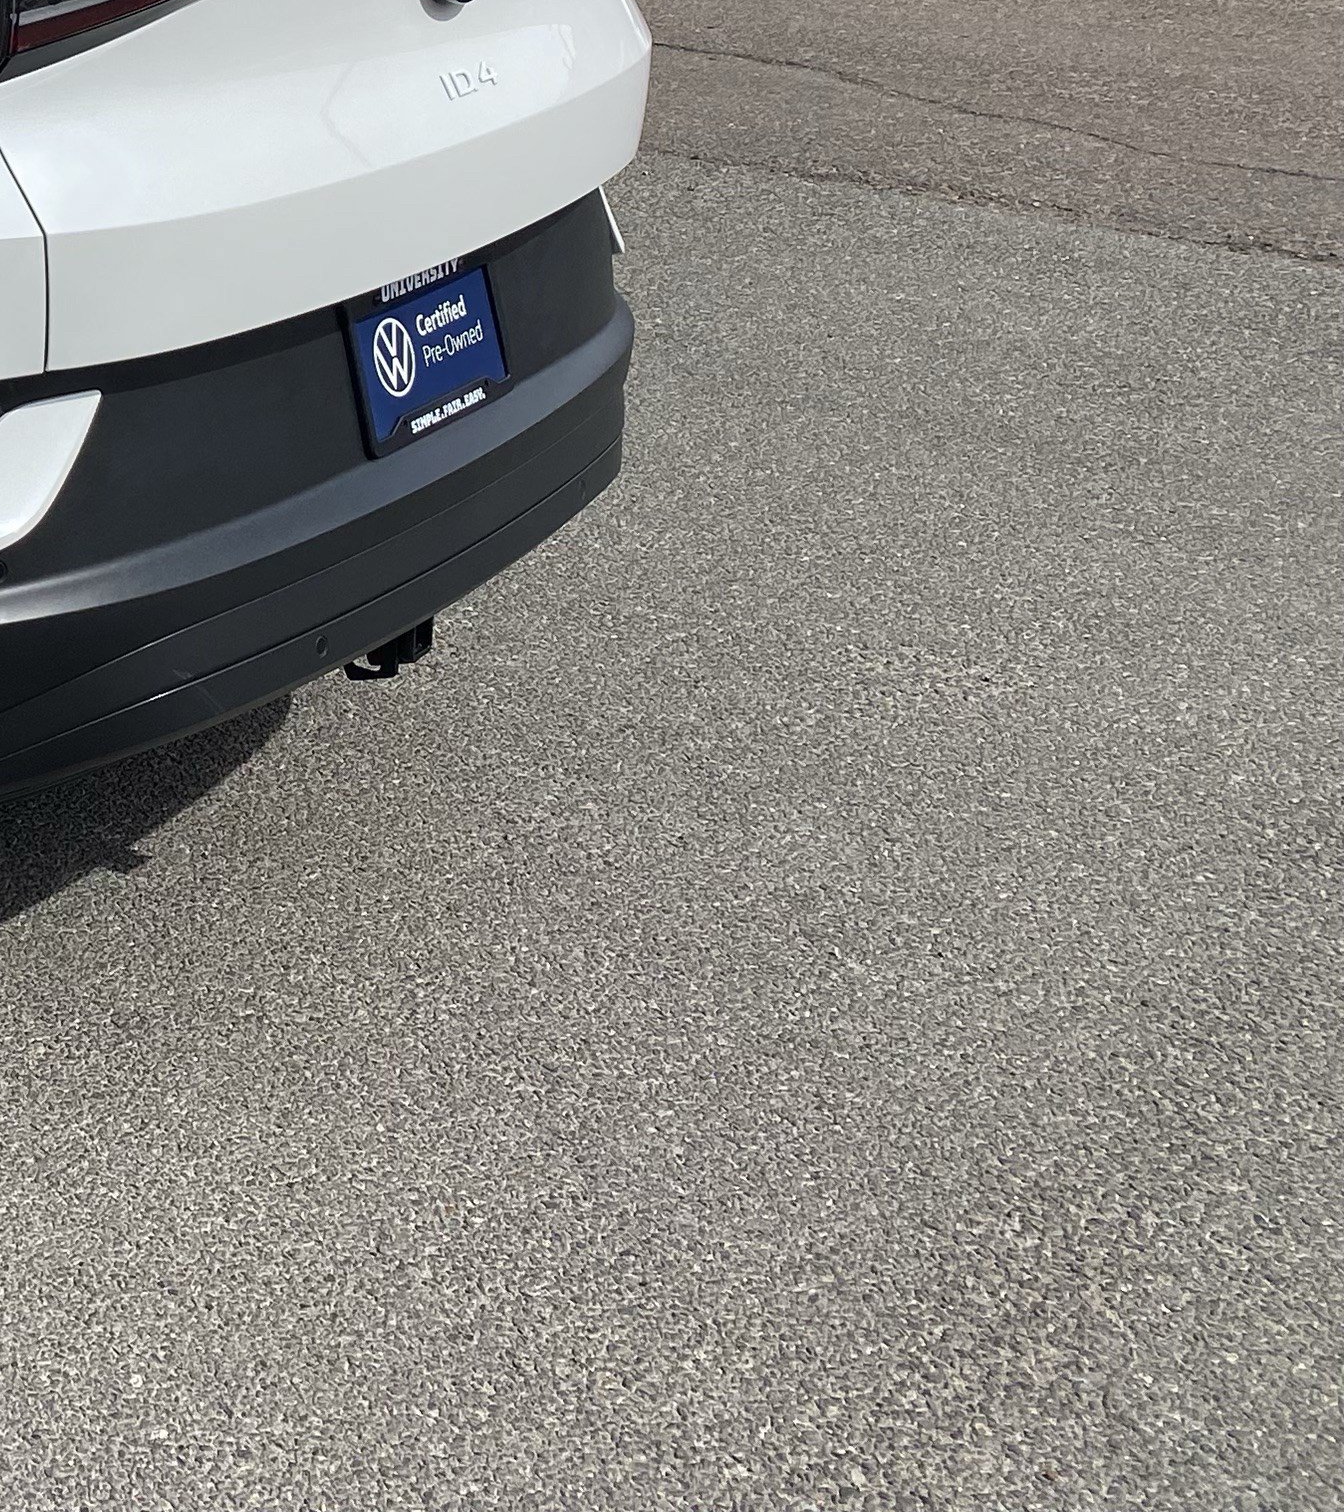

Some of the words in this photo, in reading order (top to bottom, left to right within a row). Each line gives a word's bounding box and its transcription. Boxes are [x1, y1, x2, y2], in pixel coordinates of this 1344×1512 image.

[381, 258, 460, 303] UNIVERSITY
[415, 294, 467, 337] Certified
[423, 319, 484, 367] Pre-Owned
